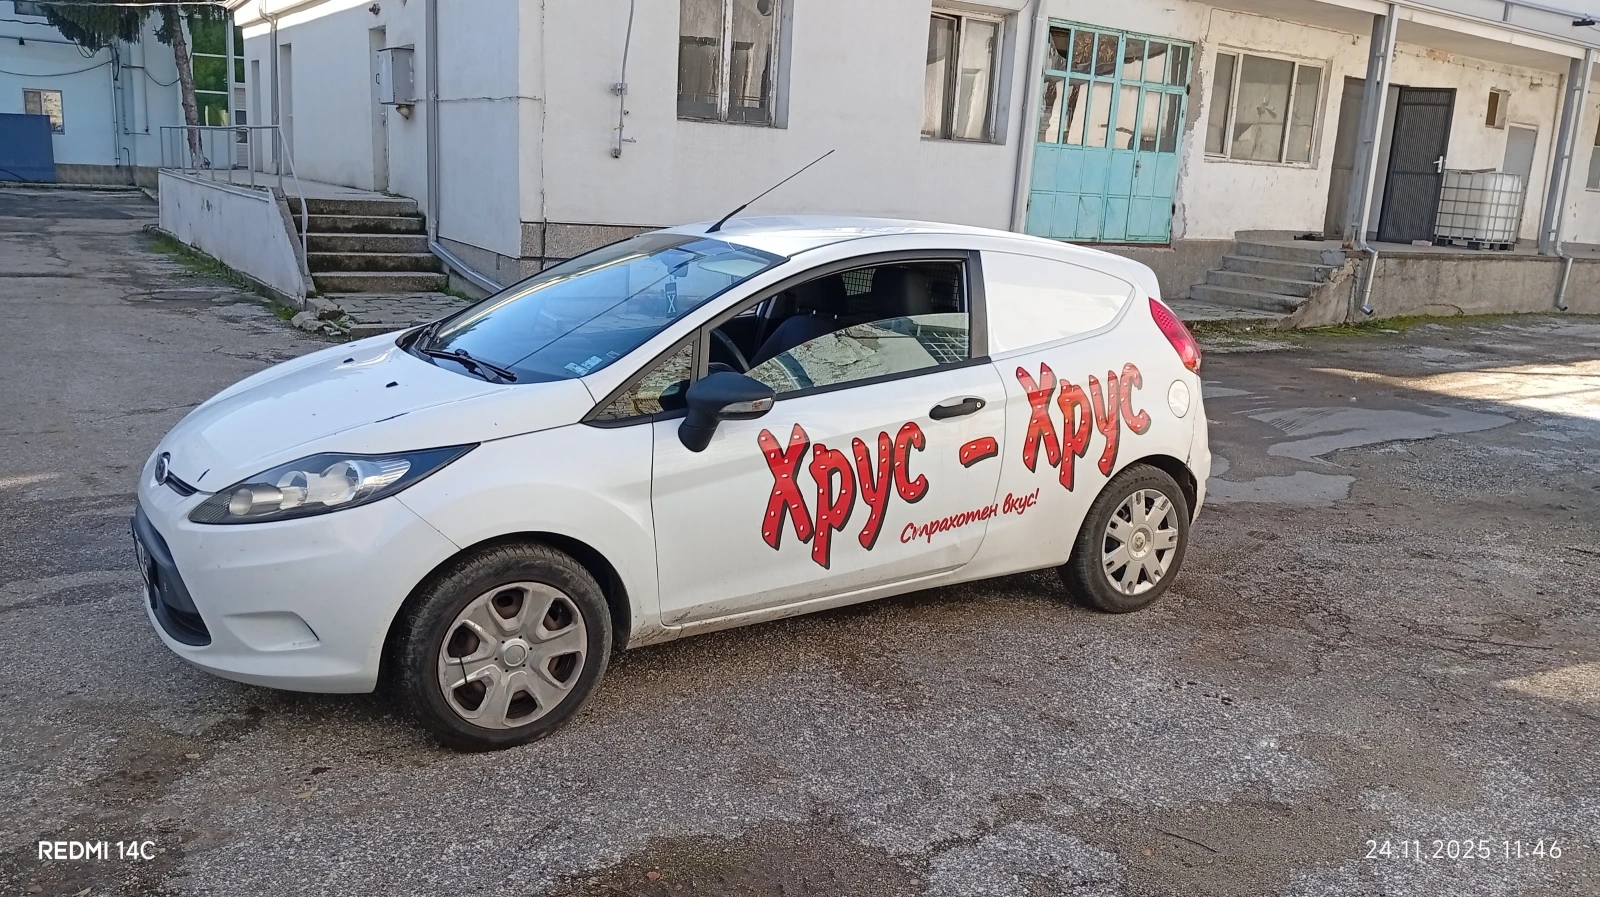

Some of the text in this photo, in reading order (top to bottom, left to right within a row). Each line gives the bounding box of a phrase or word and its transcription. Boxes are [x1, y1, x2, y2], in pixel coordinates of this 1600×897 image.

[757, 421, 929, 569] Хрус
[1016, 362, 1151, 492] Хрус
[900, 487, 1040, 543] Страхотен вкус!
